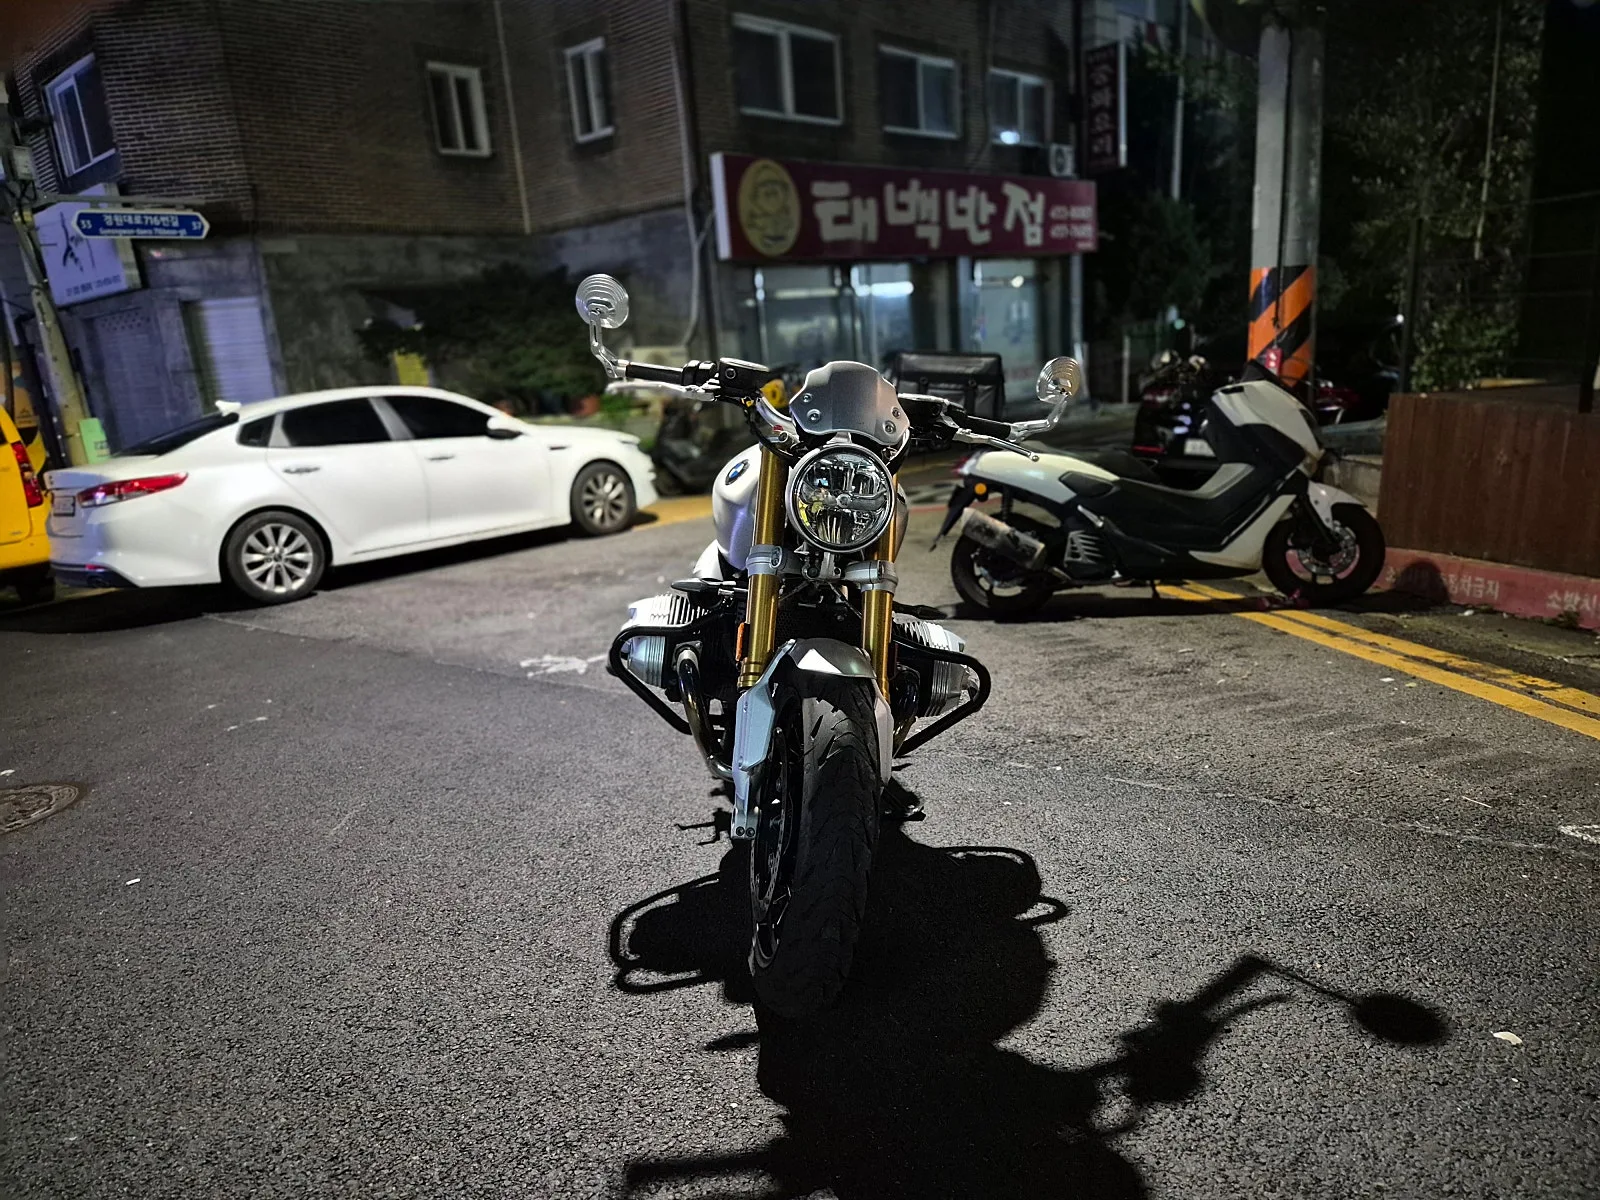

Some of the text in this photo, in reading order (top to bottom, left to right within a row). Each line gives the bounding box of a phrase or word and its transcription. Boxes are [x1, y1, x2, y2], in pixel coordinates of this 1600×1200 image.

[103, 214, 180, 228] 경원대로716번길
[810, 178, 1046, 250] 태백반점
[79, 218, 93, 230] 33
